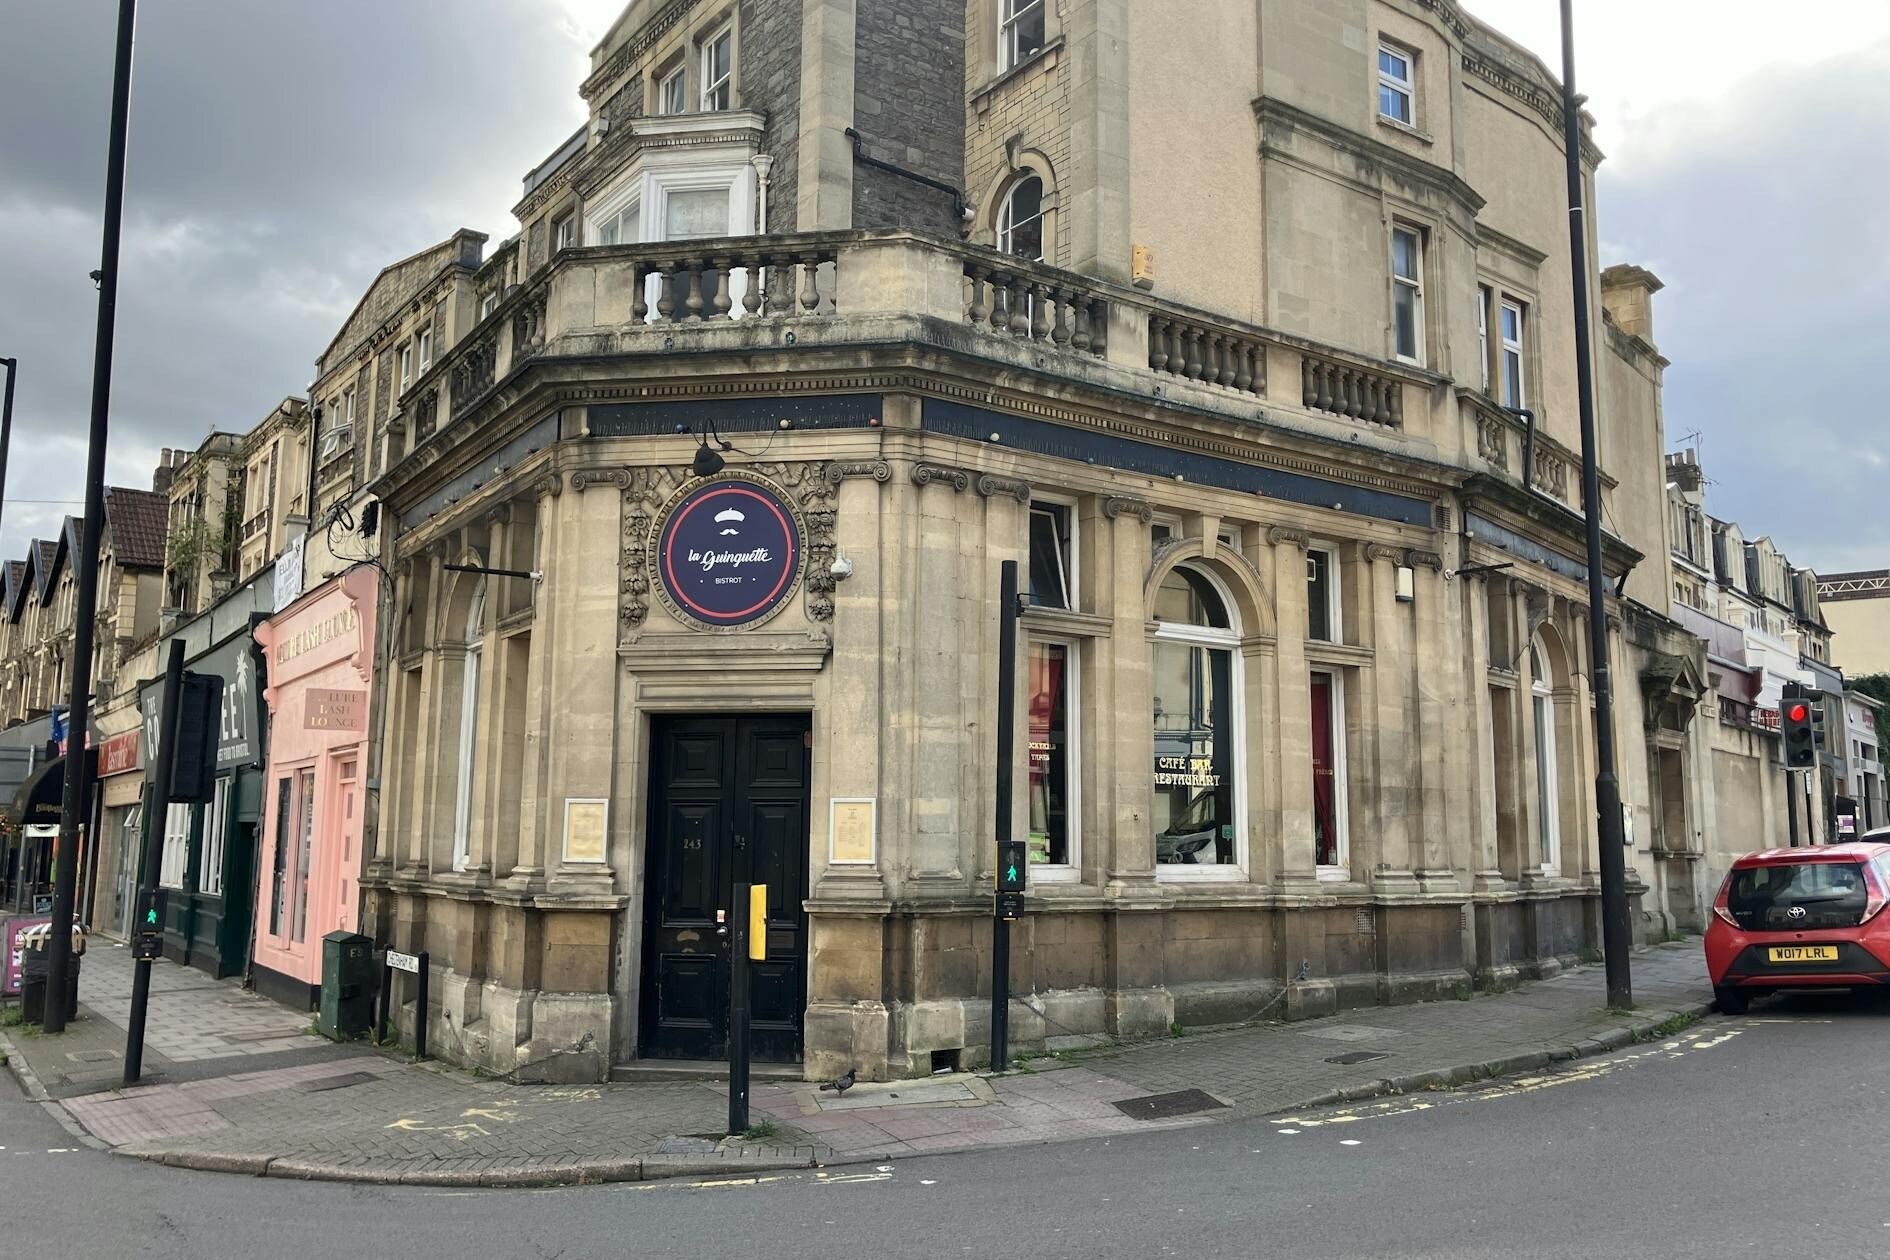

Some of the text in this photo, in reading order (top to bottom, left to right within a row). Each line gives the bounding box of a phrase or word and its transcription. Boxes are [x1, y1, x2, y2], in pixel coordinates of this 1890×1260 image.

[688, 547, 773, 572] la Guinguette
[715, 576, 743, 585] BISTROT
[320, 704, 351, 715] LASH
[311, 716, 358, 728] LONGE
[1159, 756, 1186, 769] CAFÉ
[1153, 772, 1220, 786] RESTAURANT
[683, 838, 702, 850] 243
[1776, 948, 1830, 959] WO17 LRL
